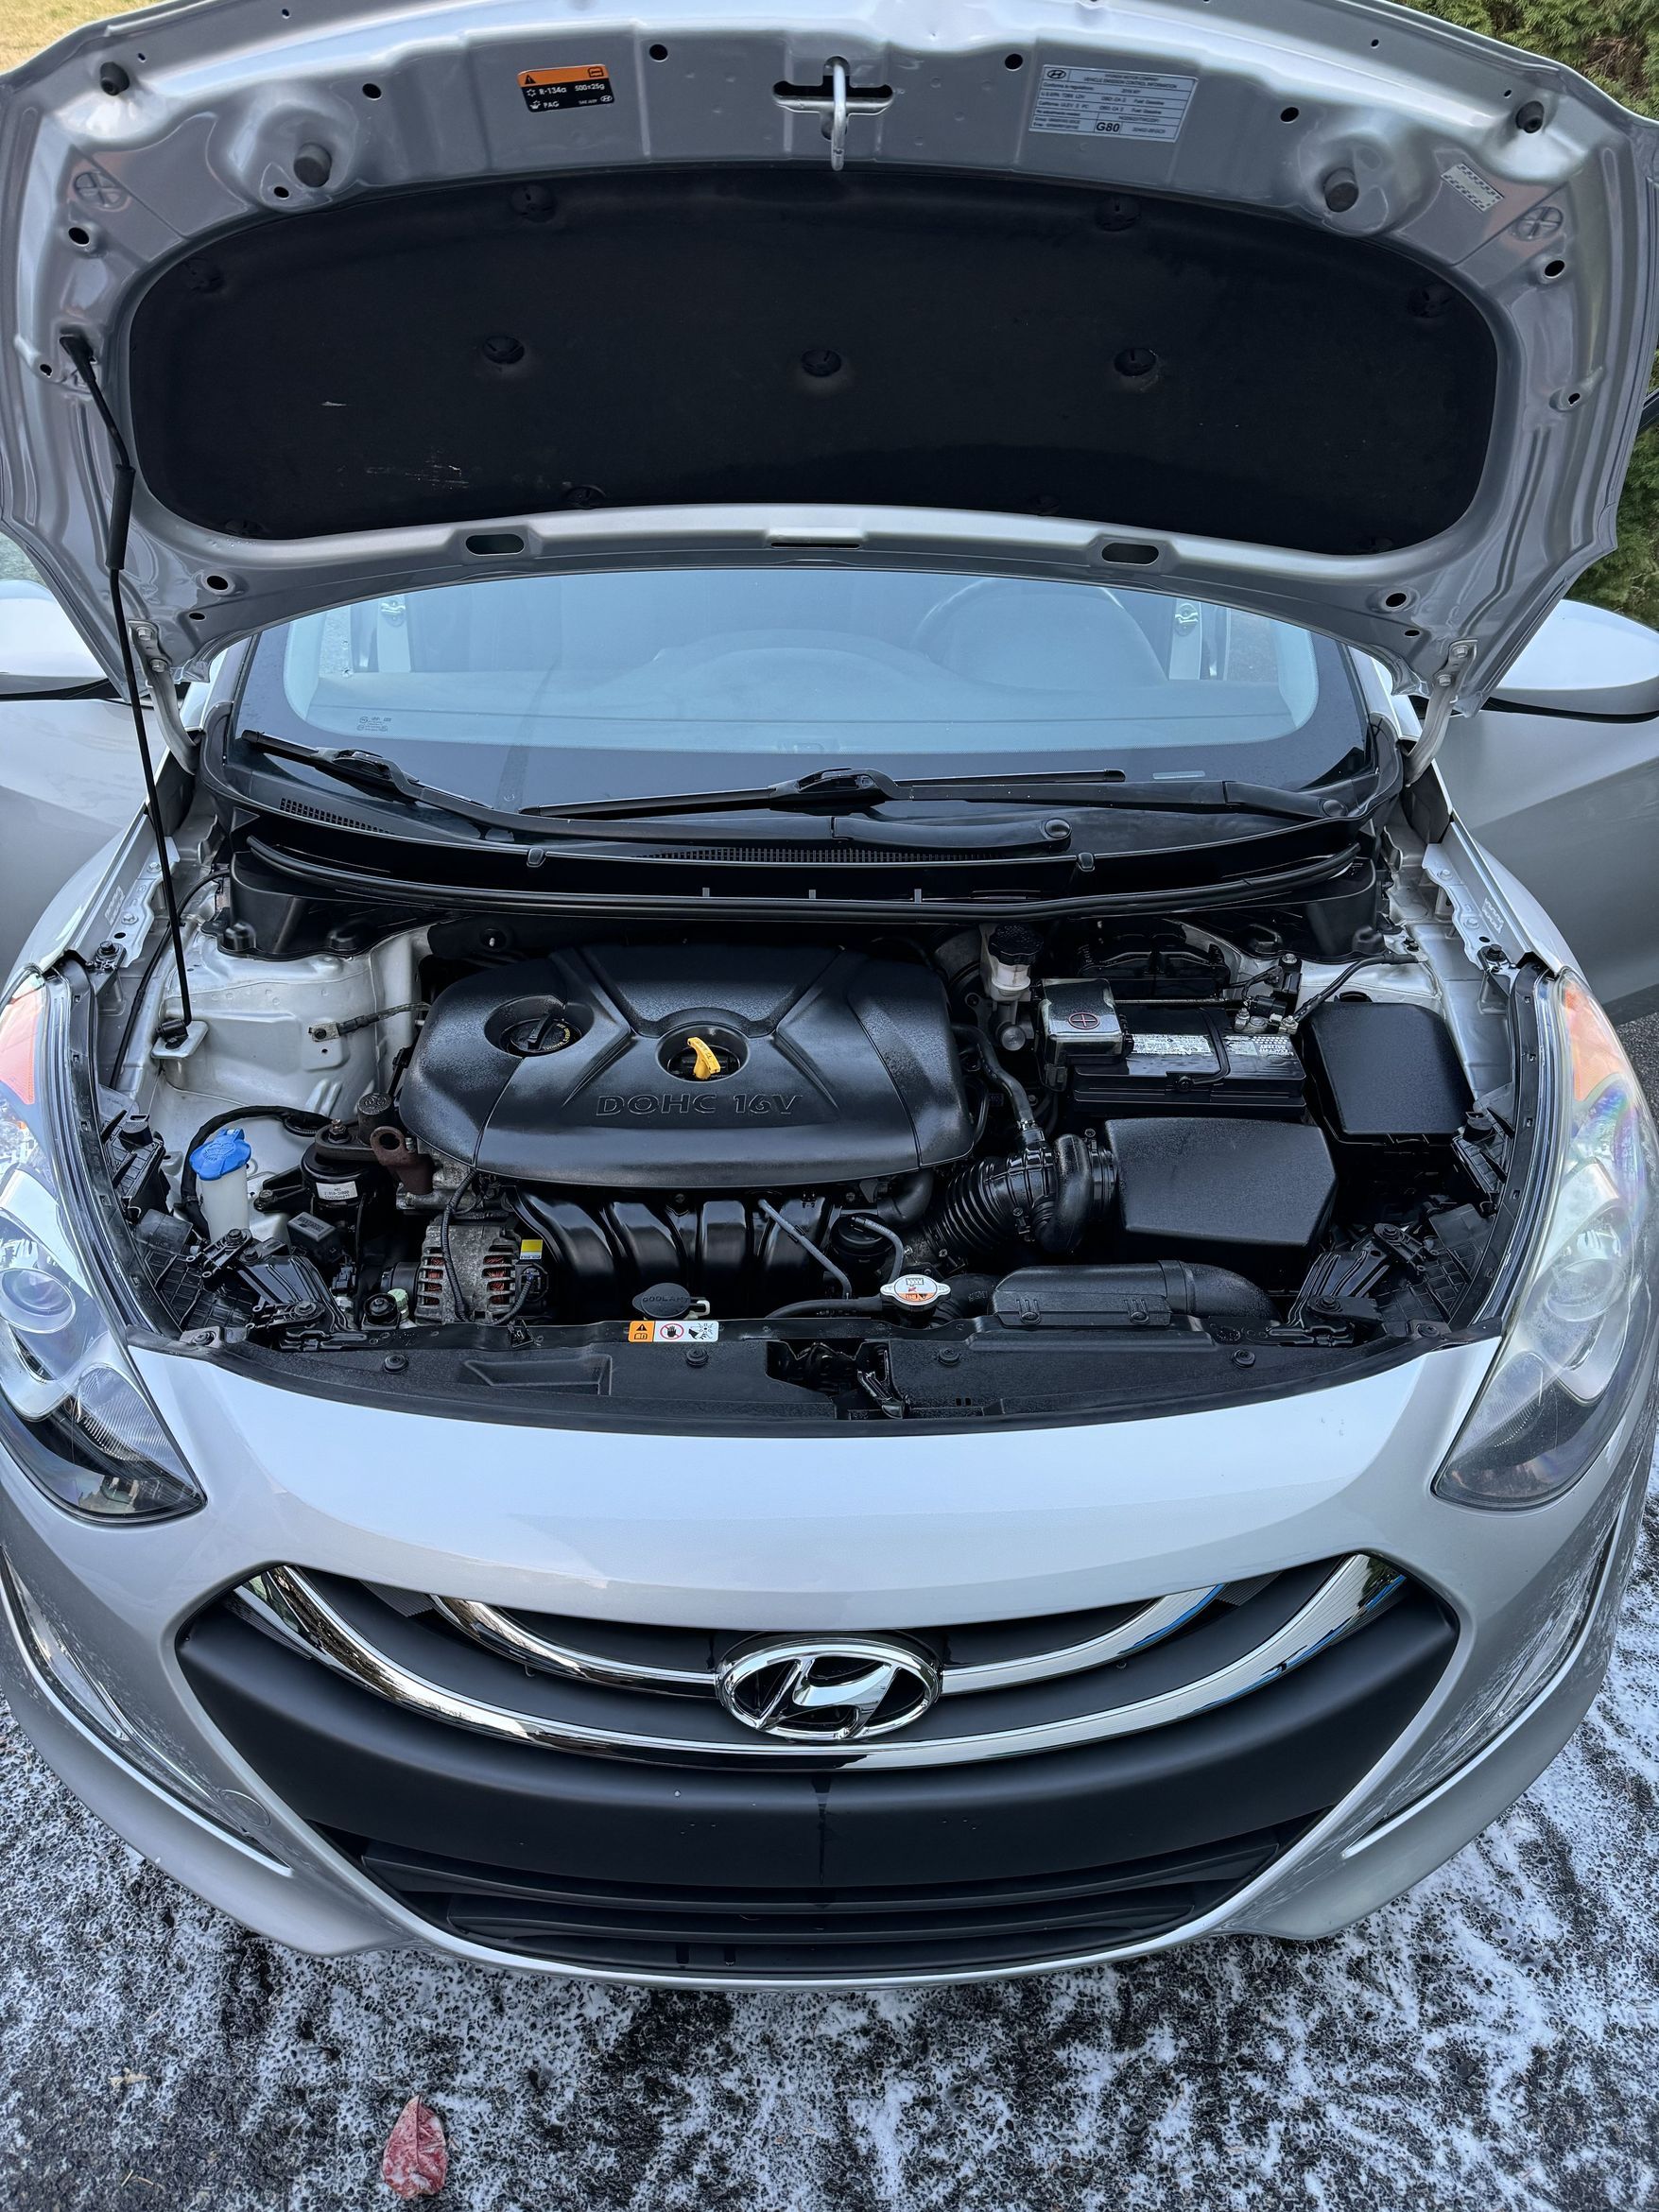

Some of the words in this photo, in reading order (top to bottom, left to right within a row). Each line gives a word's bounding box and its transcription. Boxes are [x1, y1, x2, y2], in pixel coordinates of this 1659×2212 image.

[539, 86, 567, 95] R-134a
[543, 100, 560, 109] PAG
[1096, 121, 1120, 132] G80
[596, 1094, 717, 1116] DOHC
[733, 1094, 803, 1115] 16V
